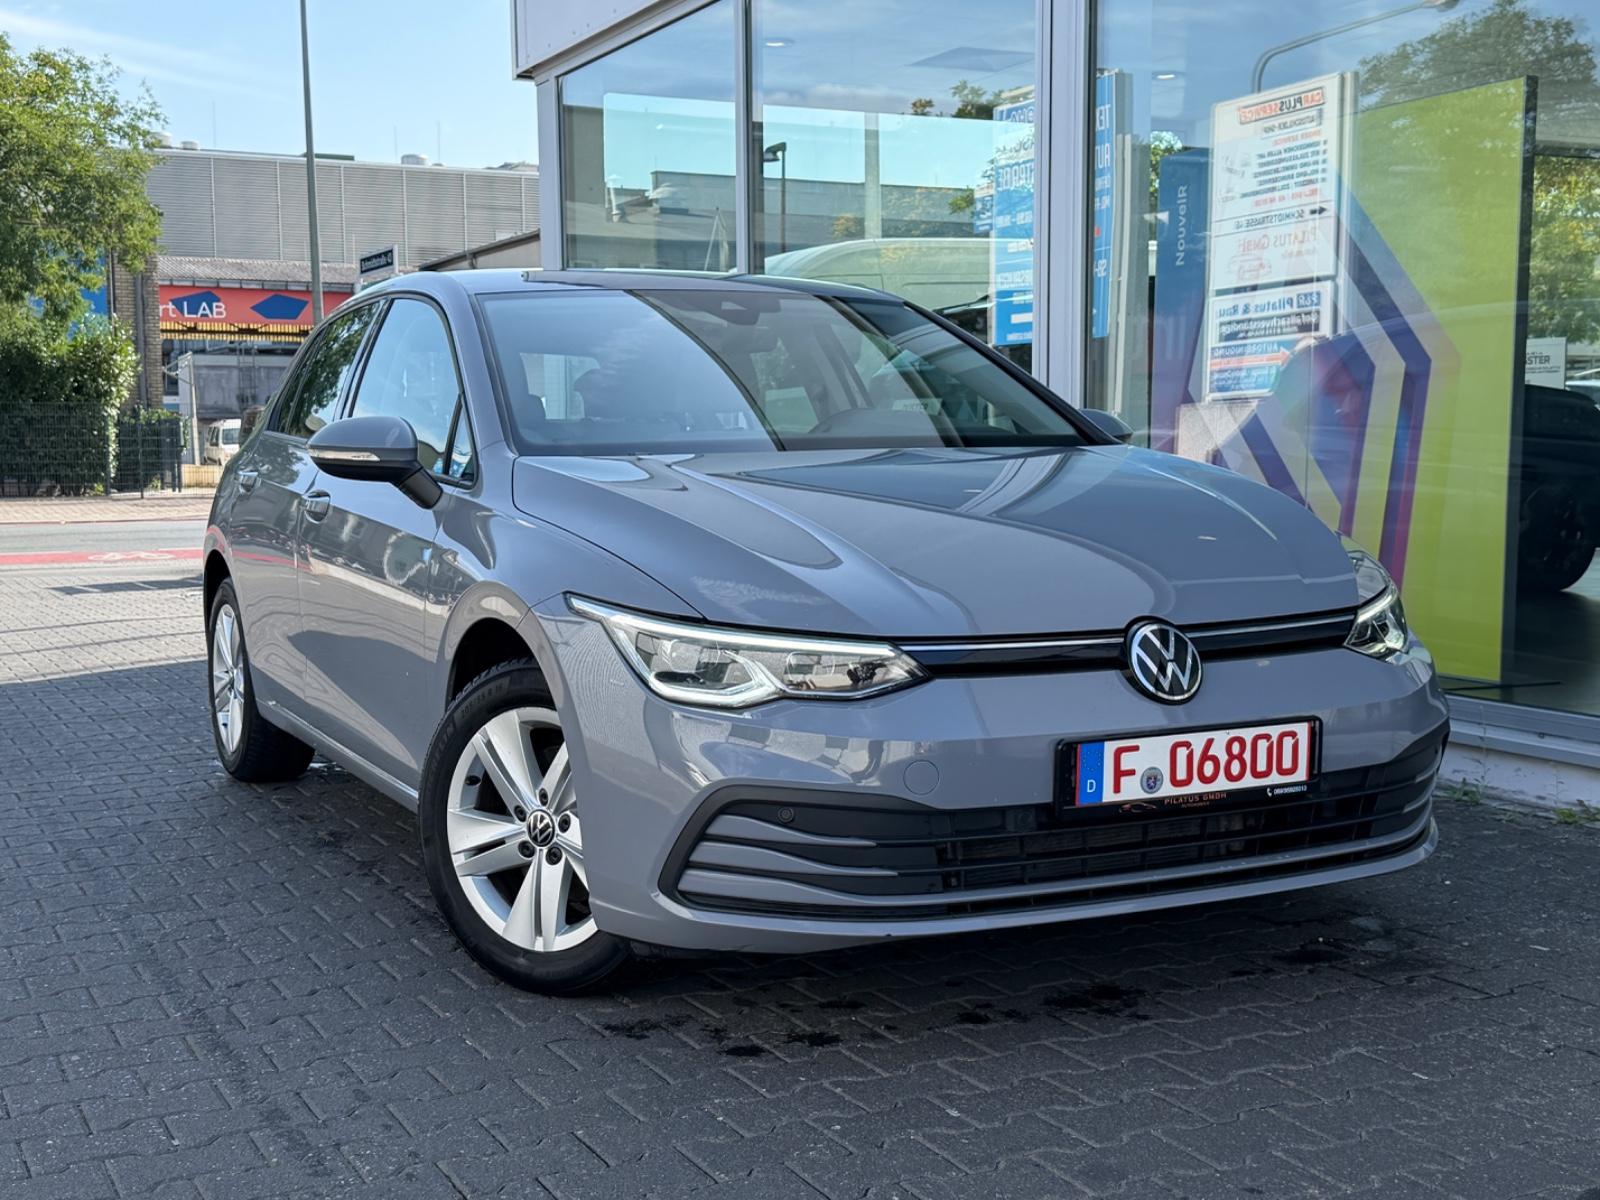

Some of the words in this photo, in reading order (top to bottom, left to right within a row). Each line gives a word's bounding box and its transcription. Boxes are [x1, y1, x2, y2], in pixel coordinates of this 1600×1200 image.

[183, 301, 226, 318] LAB
[1113, 744, 1140, 794] F
[1169, 730, 1300, 788] 06800
[1086, 779, 1096, 793] D
